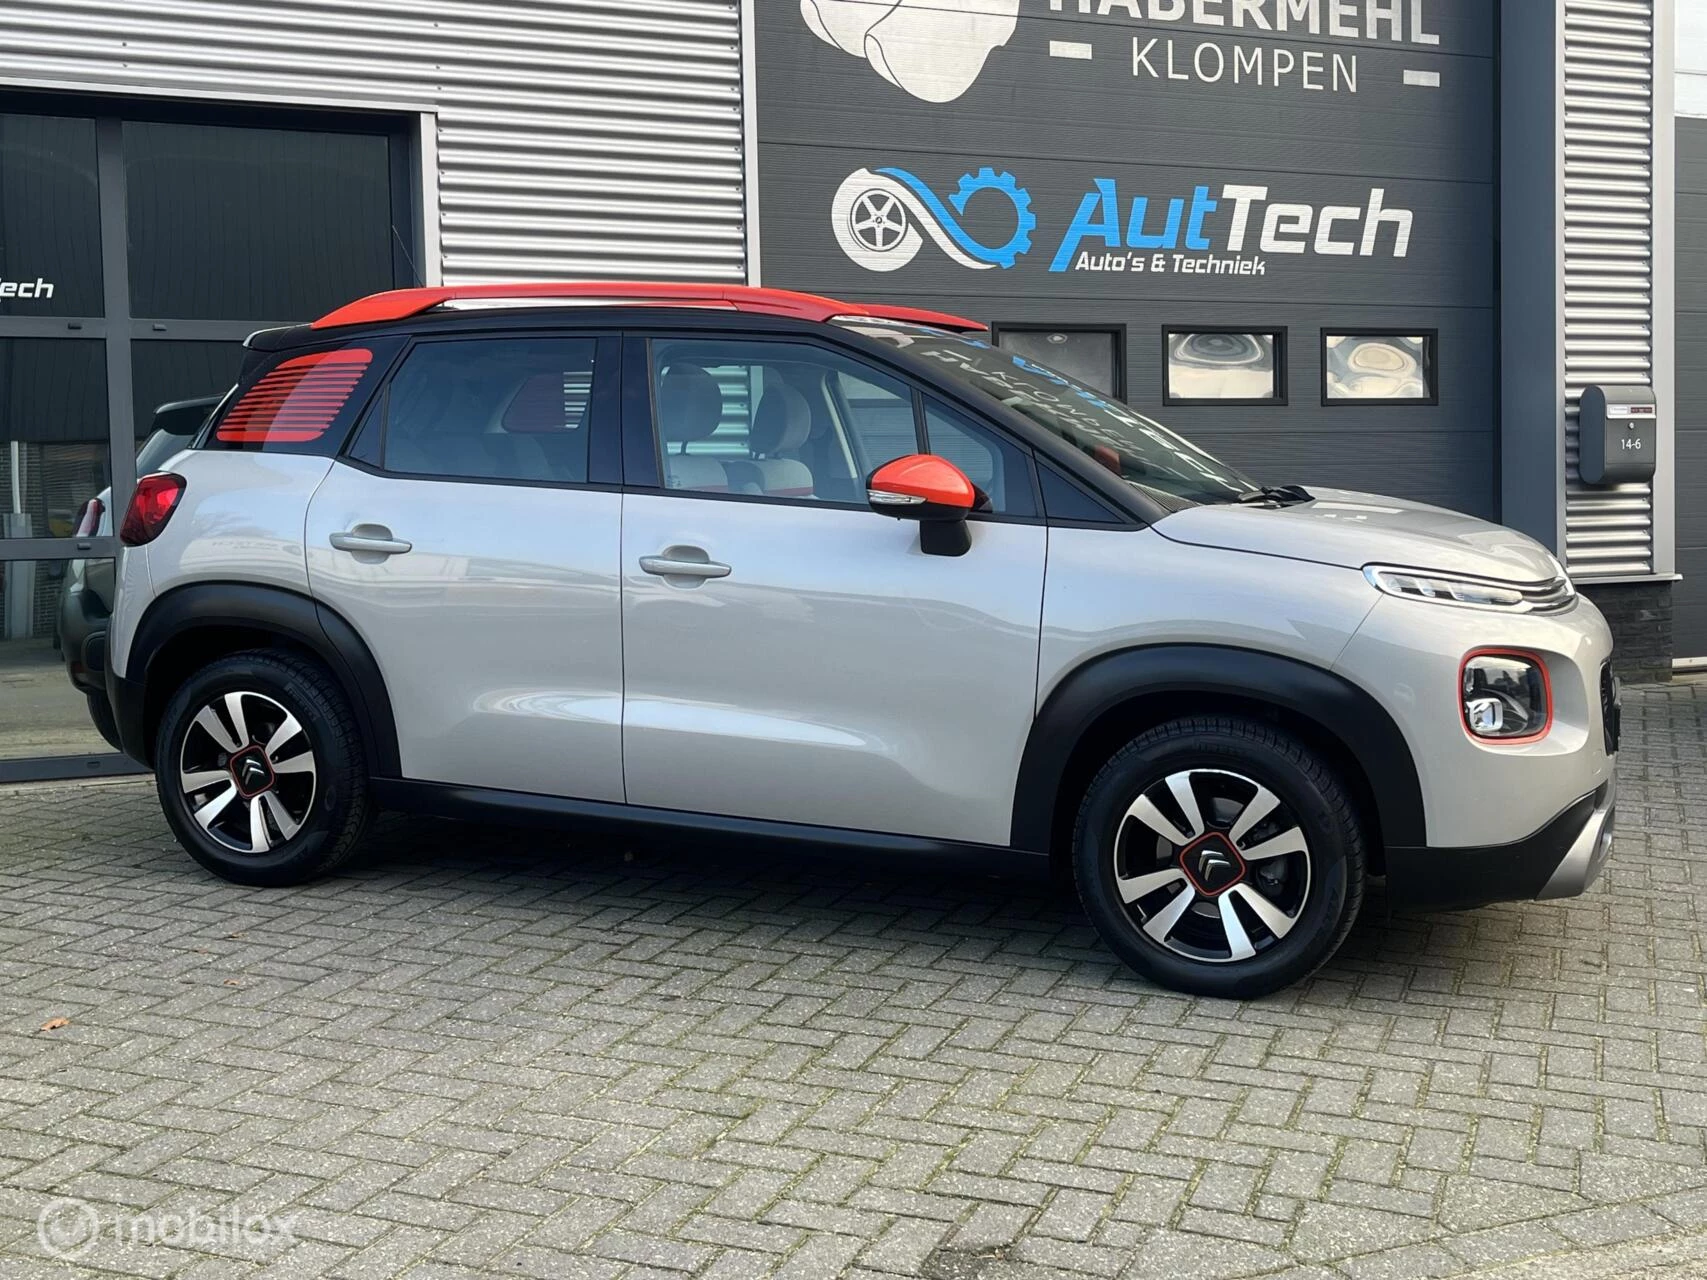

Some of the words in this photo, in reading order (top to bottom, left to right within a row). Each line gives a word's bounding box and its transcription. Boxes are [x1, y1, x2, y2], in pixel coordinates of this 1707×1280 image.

[1050, 0, 1440, 45] RMEHL
[1132, 36, 1357, 93] KLOMPEN
[1048, 178, 1414, 273] AutTech
[1074, 250, 1146, 272] Auto's
[1150, 252, 1166, 273] &
[1172, 254, 1266, 276] Techniek
[0, 277, 54, 299] ech
[1621, 438, 1642, 450] 14-6
